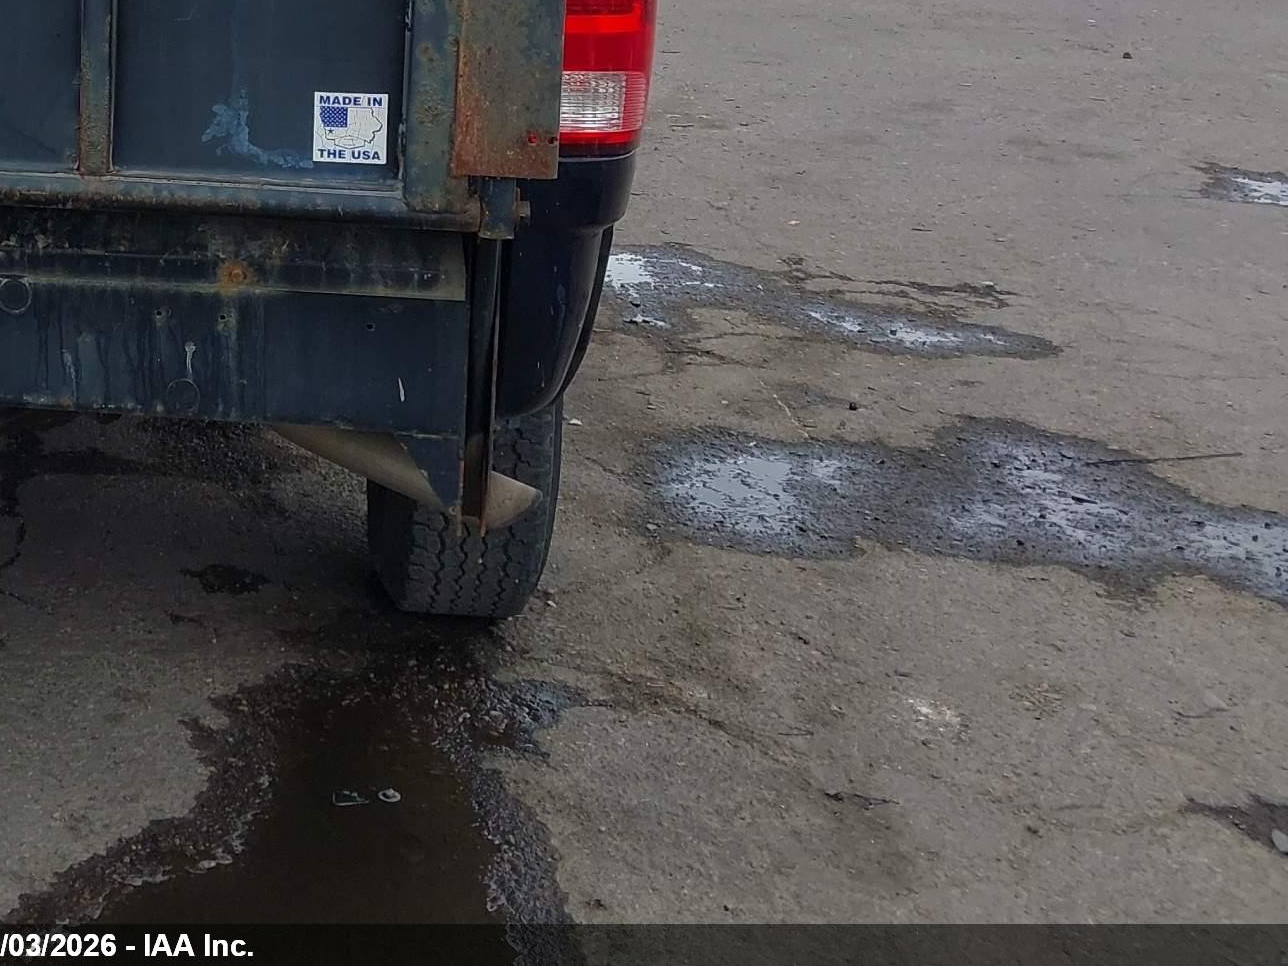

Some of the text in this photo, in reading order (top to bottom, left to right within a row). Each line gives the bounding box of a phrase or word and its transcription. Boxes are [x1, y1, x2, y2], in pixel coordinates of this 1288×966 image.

[319, 95, 383, 107] MADE IN
[317, 148, 381, 161] THE USA
